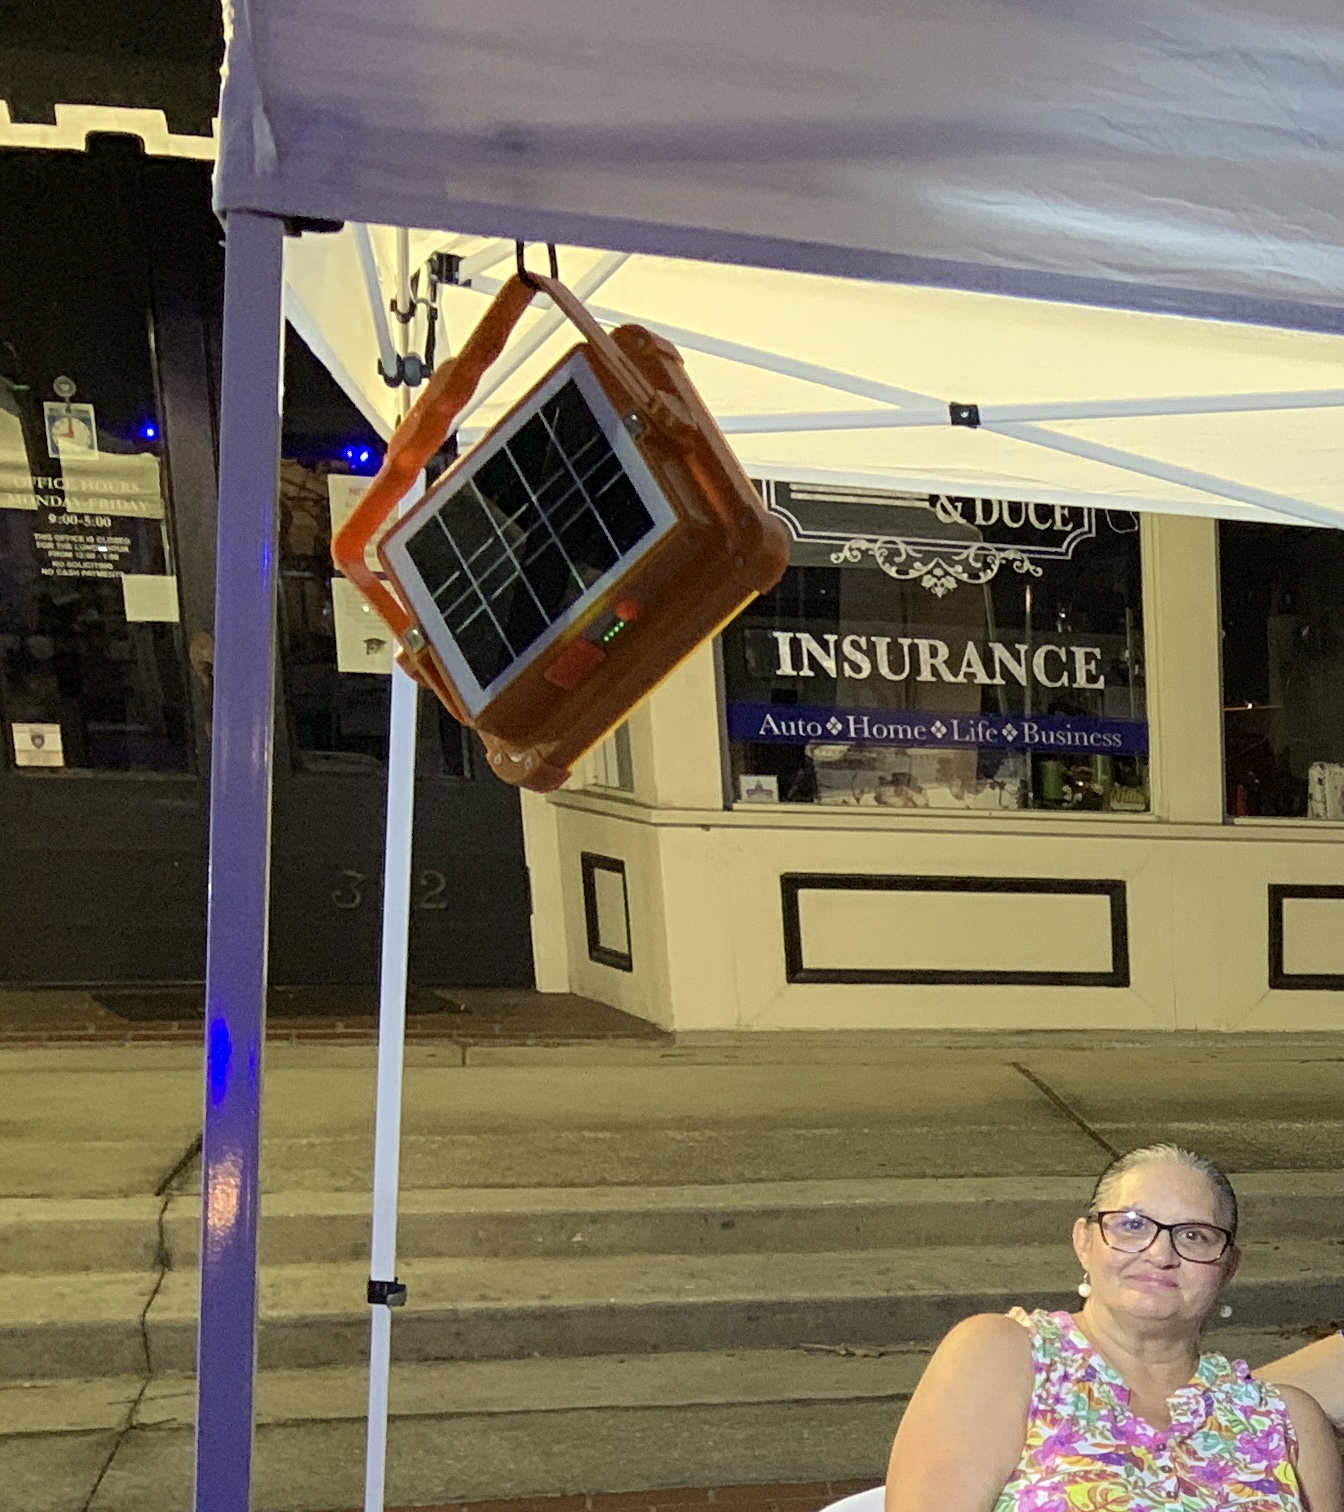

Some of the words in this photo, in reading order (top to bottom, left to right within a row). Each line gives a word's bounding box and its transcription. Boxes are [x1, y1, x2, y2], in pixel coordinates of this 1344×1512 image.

[772, 631, 1104, 689] INSURANCE
[759, 714, 822, 735] Auto
[848, 716, 925, 738] Home
[952, 720, 997, 741] Life
[1023, 723, 1122, 746] Business
[332, 868, 449, 909] 32
